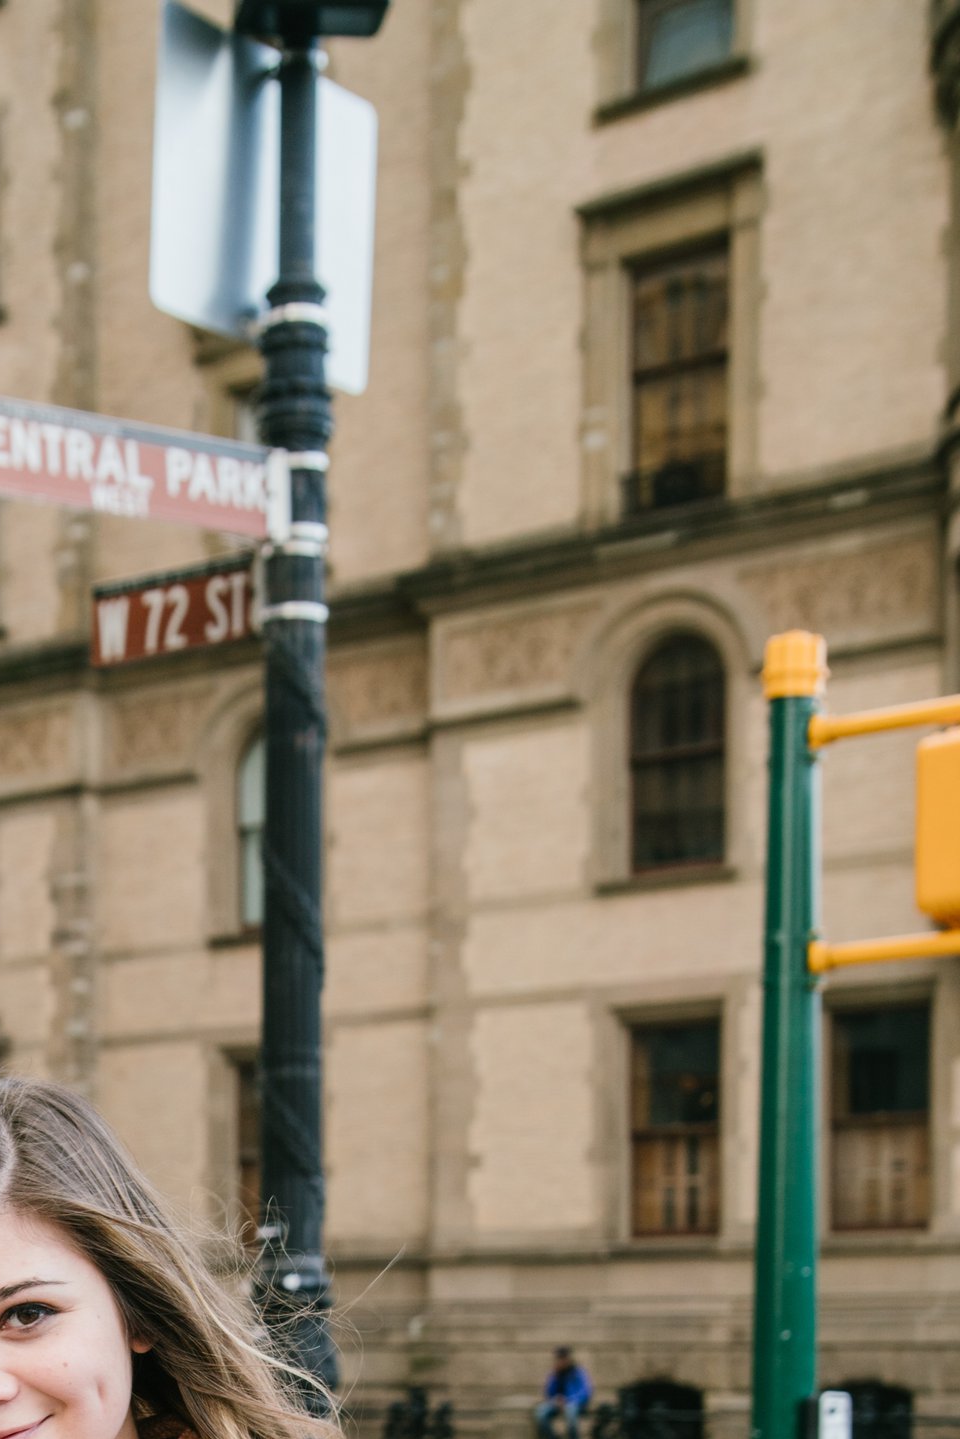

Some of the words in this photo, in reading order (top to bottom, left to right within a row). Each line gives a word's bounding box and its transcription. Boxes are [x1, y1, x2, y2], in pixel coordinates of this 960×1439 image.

[165, 446, 271, 514] PARK
[97, 597, 130, 662] W
[142, 584, 191, 656] 72
[204, 571, 247, 648] ST
